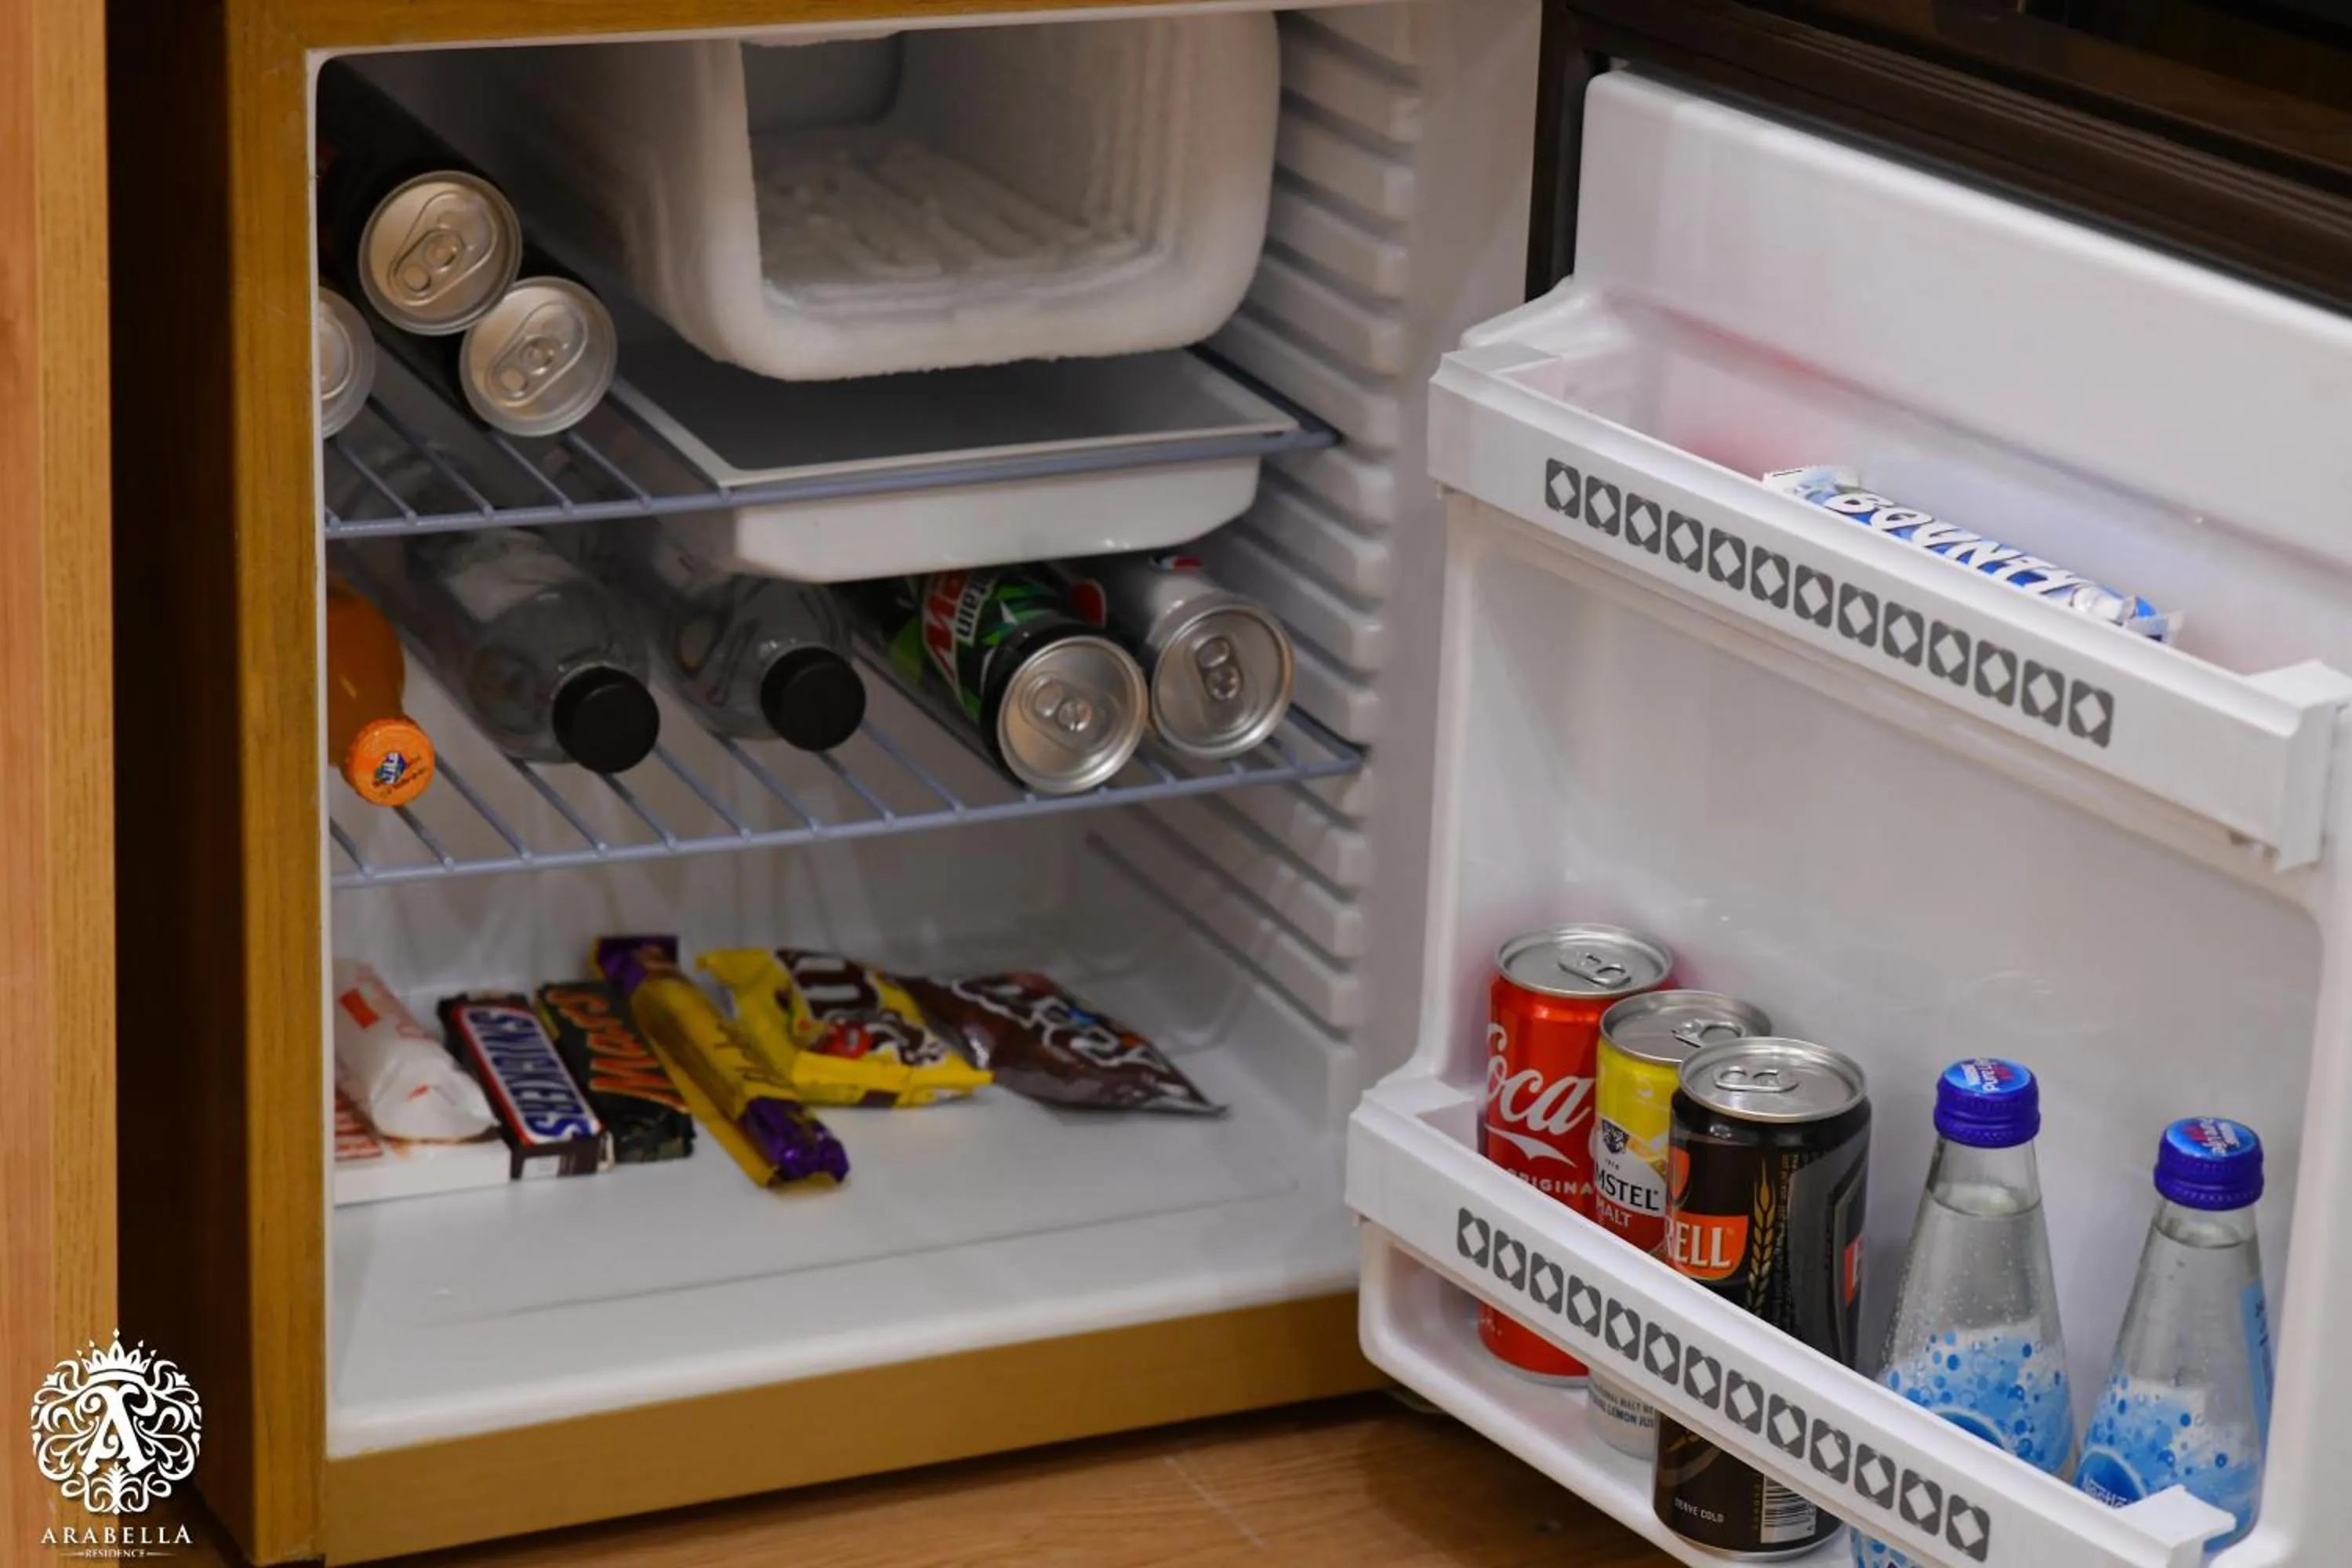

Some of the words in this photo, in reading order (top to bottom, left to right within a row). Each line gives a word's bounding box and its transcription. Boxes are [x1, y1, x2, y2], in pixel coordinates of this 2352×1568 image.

[1595, 1163, 1659, 1210] MSTEL
[1664, 1216, 1732, 1269] RELL
[1700, 1508, 1725, 1524] COLD
